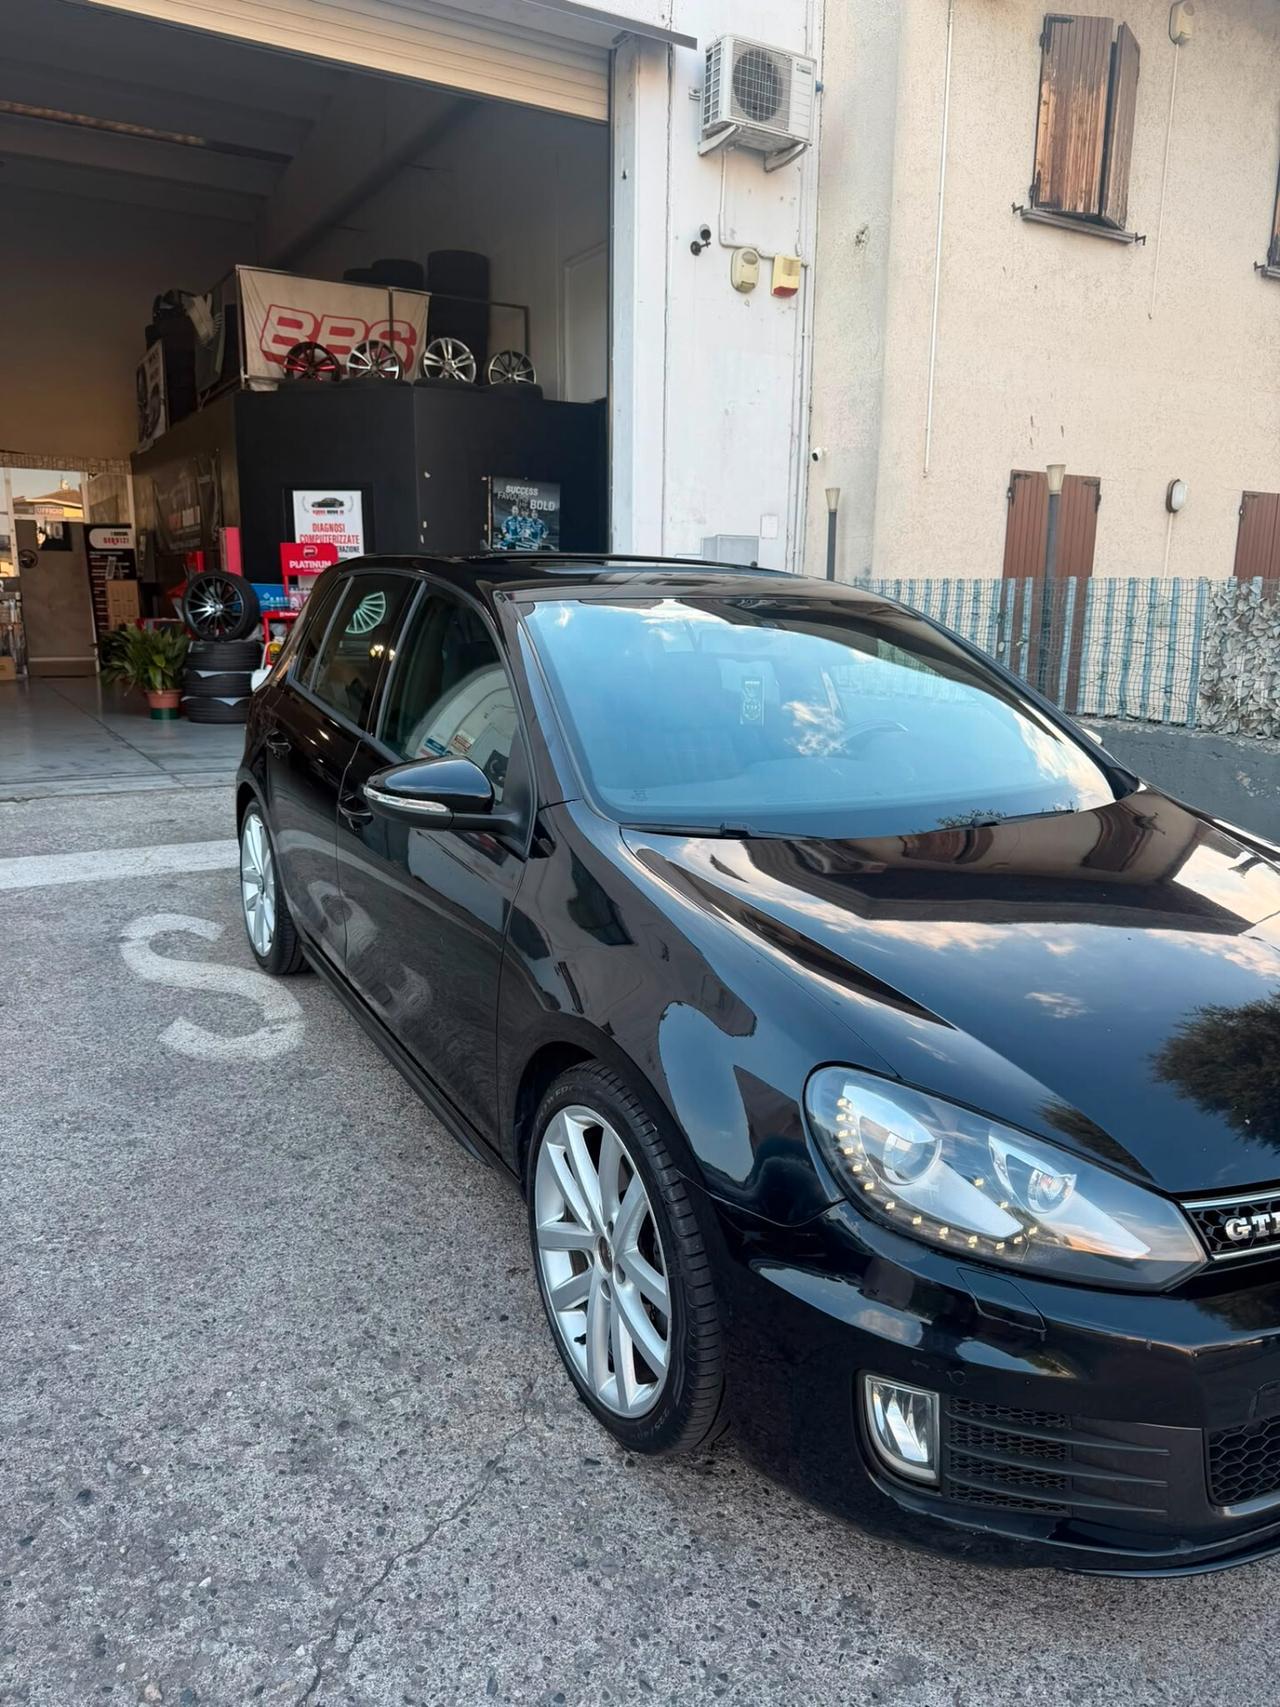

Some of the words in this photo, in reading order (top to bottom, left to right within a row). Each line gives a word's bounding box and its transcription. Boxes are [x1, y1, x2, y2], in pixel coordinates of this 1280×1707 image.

[260, 304, 417, 376] BBS
[505, 485, 538, 496] SUCCESS
[530, 499, 556, 511] BOLD
[312, 523, 346, 533] DIAGNOSI
[299, 534, 360, 545] COMPUTERIZZATE
[289, 560, 332, 569] PLATINUM
